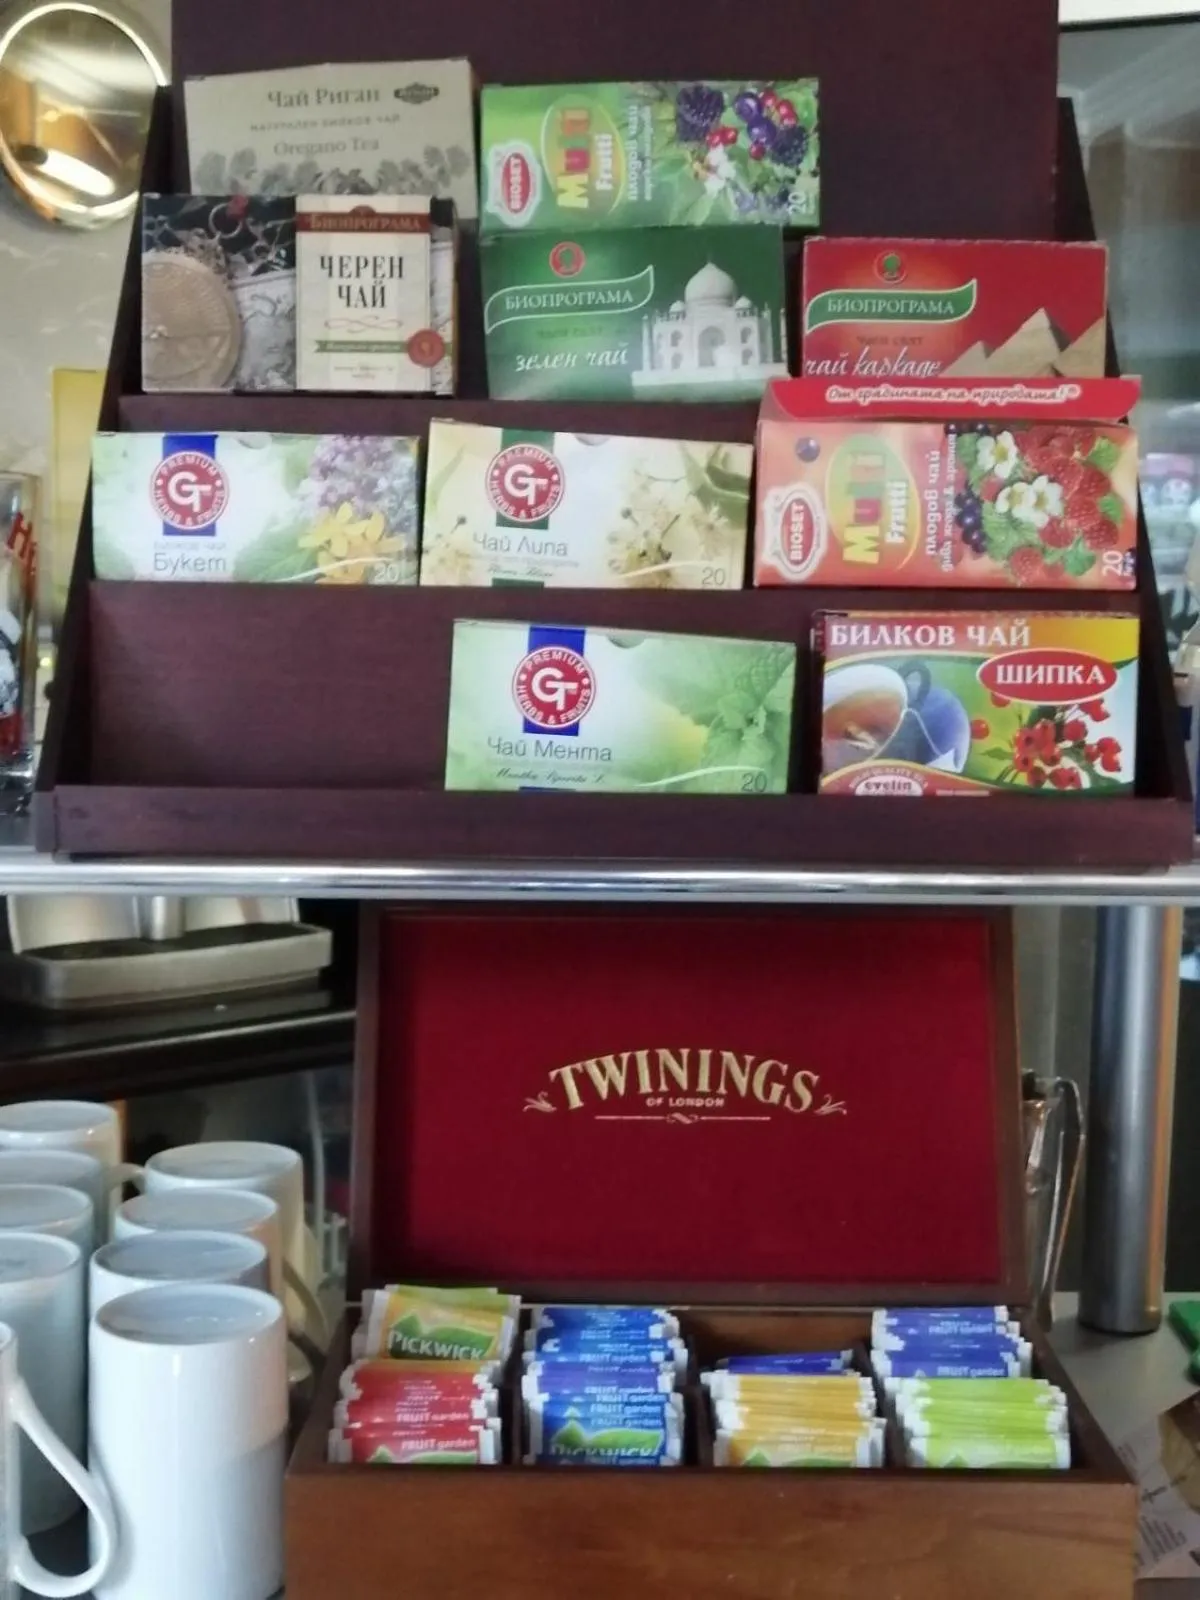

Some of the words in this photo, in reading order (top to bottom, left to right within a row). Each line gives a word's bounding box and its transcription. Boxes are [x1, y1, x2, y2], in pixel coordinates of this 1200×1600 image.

[268, 88, 309, 108] Чай
[316, 87, 380, 105] Риган
[273, 140, 347, 156] Oregano
[351, 137, 380, 151] Tea
[595, 133, 614, 191] Frutti
[320, 254, 404, 279] ЧЕРЕН
[338, 280, 387, 309] ЧАЙ
[505, 289, 634, 310] БИОПРОГРАМА
[827, 298, 954, 315] БИОПРОГРАМА
[515, 352, 578, 373] зелен
[586, 341, 630, 367] чай
[885, 480, 910, 544] Frutti
[790, 501, 806, 561] BIOSET
[472, 531, 511, 552] Чай
[517, 536, 569, 557] Липа
[153, 552, 227, 576] Букет
[1102, 550, 1123, 577] 20
[702, 566, 727, 587] 20
[830, 624, 955, 647] БИЛКОВ
[967, 617, 1030, 647] ЧАЙ
[525, 649, 586, 674] PREMIUM
[995, 663, 1107, 686] ШИПКА
[487, 735, 527, 757] Чай
[534, 740, 613, 761] Мента
[741, 772, 767, 793] 20
[548, 1047, 820, 1114] TWININGS
[646, 1097, 664, 1107] OF
[668, 1097, 725, 1108] LONDON
[387, 1330, 484, 1361] PICKWICK
[401, 1438, 436, 1450] FRUIT
